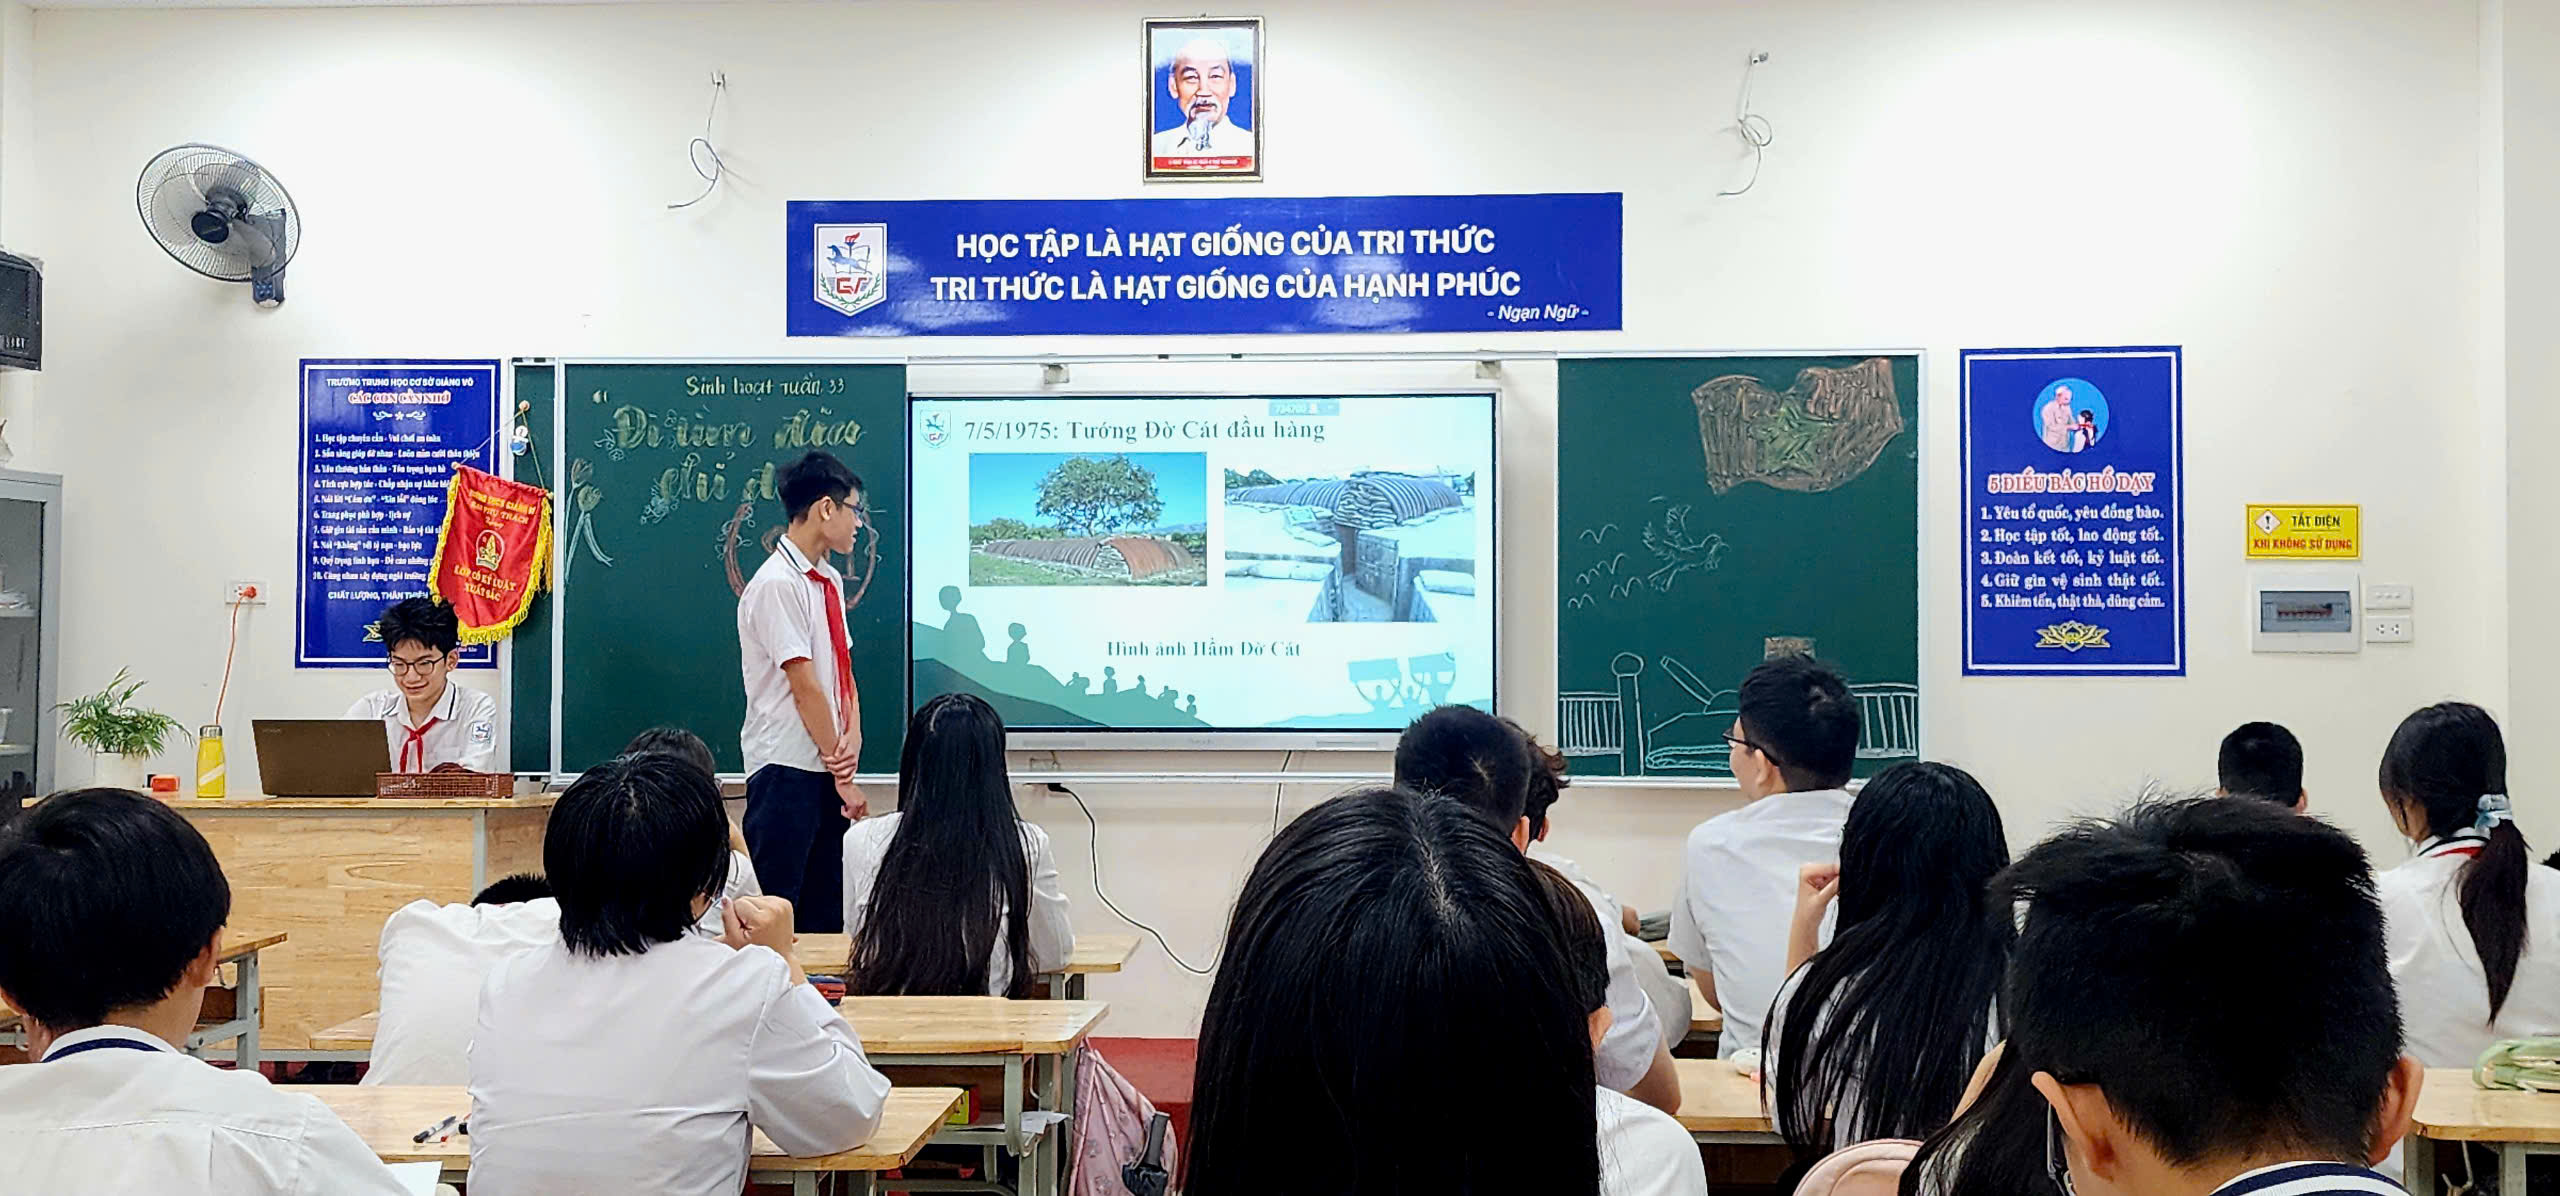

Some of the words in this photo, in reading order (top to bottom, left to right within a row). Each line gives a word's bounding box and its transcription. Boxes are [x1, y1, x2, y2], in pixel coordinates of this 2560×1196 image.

[957, 233, 1018, 264] HỌC
[1025, 228, 1080, 264] TẬP
[1087, 228, 1122, 256] LÀ
[1130, 232, 1186, 263] HẠT
[1192, 223, 1284, 256] GIỐNG
[1291, 223, 1353, 255] CỦA
[1358, 230, 1404, 254] TRI
[1411, 222, 1495, 254] THỨC
[931, 276, 975, 301] TRI
[982, 270, 1064, 300] THỨC
[1072, 270, 1107, 299] LÀ
[1115, 276, 1171, 306] HẠT
[1177, 266, 1269, 299] GIỐNG
[1276, 267, 1337, 298] CỦA
[1344, 273, 1429, 304] HẠNH
[1437, 266, 1520, 296] PHÚC
[1498, 304, 1540, 323] Ngạn
[1543, 304, 1579, 322] Ngữ
[686, 376, 726, 396] Sinh
[733, 377, 774, 401] hoạt
[965, 421, 1058, 440] 7/5/1975:
[1067, 421, 1137, 444] Tướng
[1145, 421, 1176, 439] Đờ
[1182, 420, 1219, 439] Cát
[1227, 415, 1265, 438] đầu
[1274, 420, 1326, 443] hàng
[1988, 472, 1999, 493] 5
[2002, 465, 2045, 493] ĐIỀU
[2048, 468, 2086, 493] BÁC
[2086, 464, 2115, 493] HỒ
[2116, 472, 2156, 496] DẠY
[1994, 506, 2019, 519] Yêu
[2038, 504, 2073, 521] quốc,
[2075, 506, 2099, 521] yêu
[2101, 503, 2134, 522] đồng
[2136, 504, 2165, 519] bào.
[2291, 514, 2310, 527] TẮT
[1995, 528, 2020, 545] Học
[2025, 528, 2047, 545] tập
[2051, 526, 2074, 544] tốt,
[2079, 528, 2099, 542] lao
[2103, 527, 2136, 545] động
[2141, 526, 2164, 541] tốt.
[2254, 538, 2270, 549] KHI
[2273, 536, 2306, 550] KHÔNG
[1995, 551, 2029, 565] Đoàn
[2034, 549, 2056, 565] kết
[2060, 549, 2083, 567] tốt,
[2110, 551, 2136, 567] luật
[2141, 549, 2164, 564] tốt.
[1995, 573, 2020, 587] Giữ
[2024, 573, 2046, 590] gìn
[2052, 574, 2068, 590] vệ
[2073, 573, 2102, 587] sinh
[2108, 573, 2136, 590] thật
[2141, 571, 2164, 587] tốt.
[1995, 593, 2031, 608] Khiêm
[2057, 593, 2080, 611] thật
[2107, 593, 2136, 610] dũng
[1108, 641, 1149, 656] Hình
[1155, 641, 1186, 656] ảnh
[1271, 641, 1300, 656] Cát
